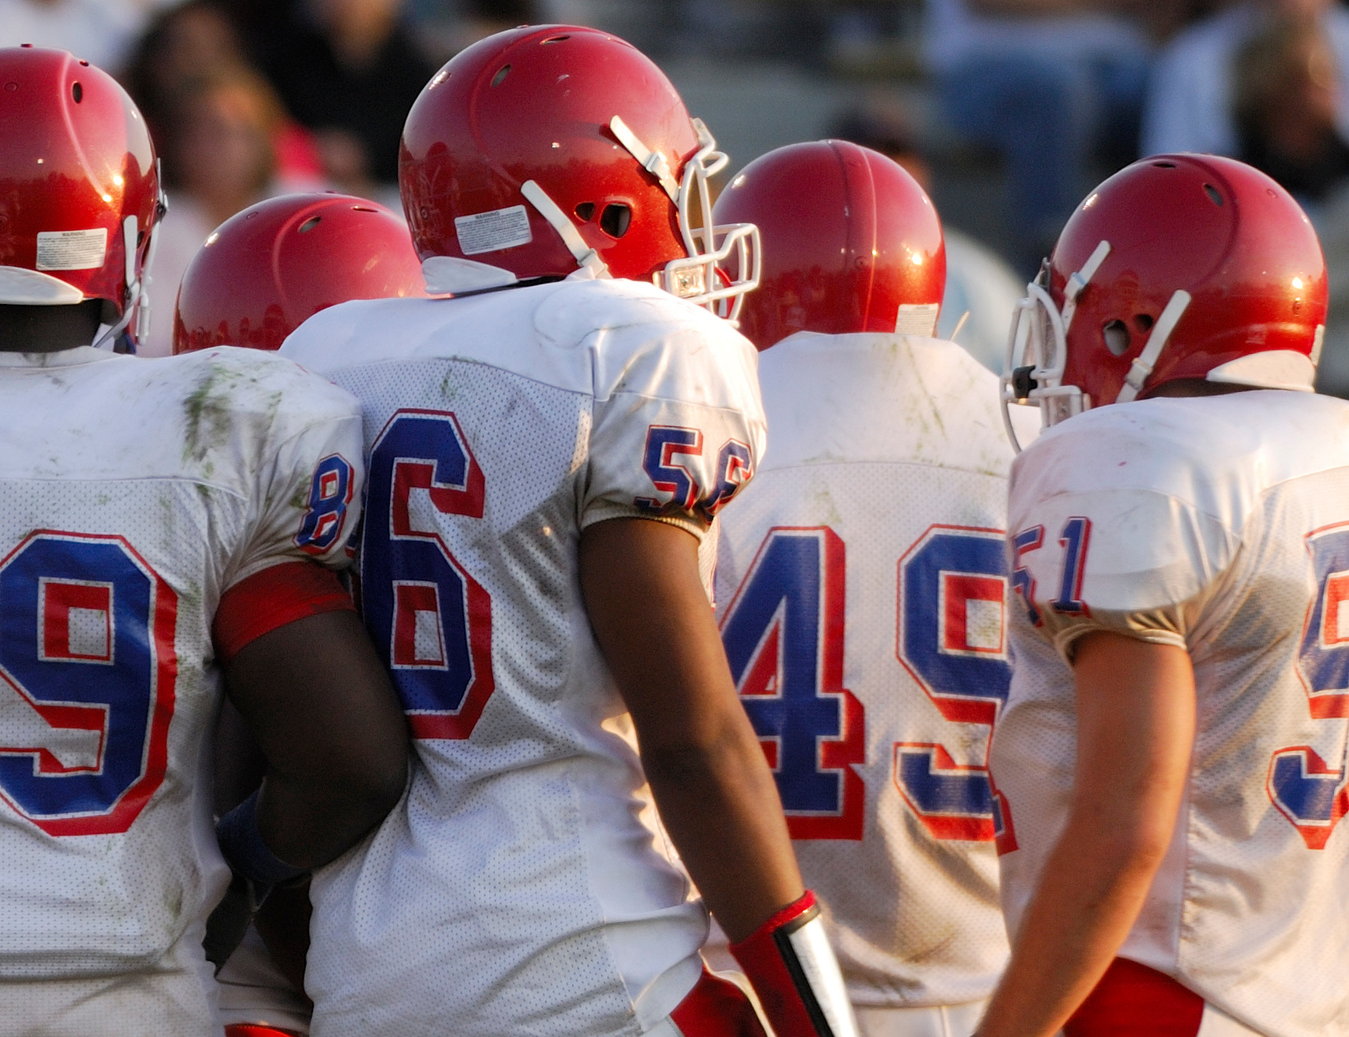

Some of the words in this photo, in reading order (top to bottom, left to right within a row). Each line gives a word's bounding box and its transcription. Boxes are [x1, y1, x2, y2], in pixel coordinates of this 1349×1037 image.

[293, 452, 357, 560] 8
[361, 408, 495, 740] 6
[717, 524, 1013, 842] 49
